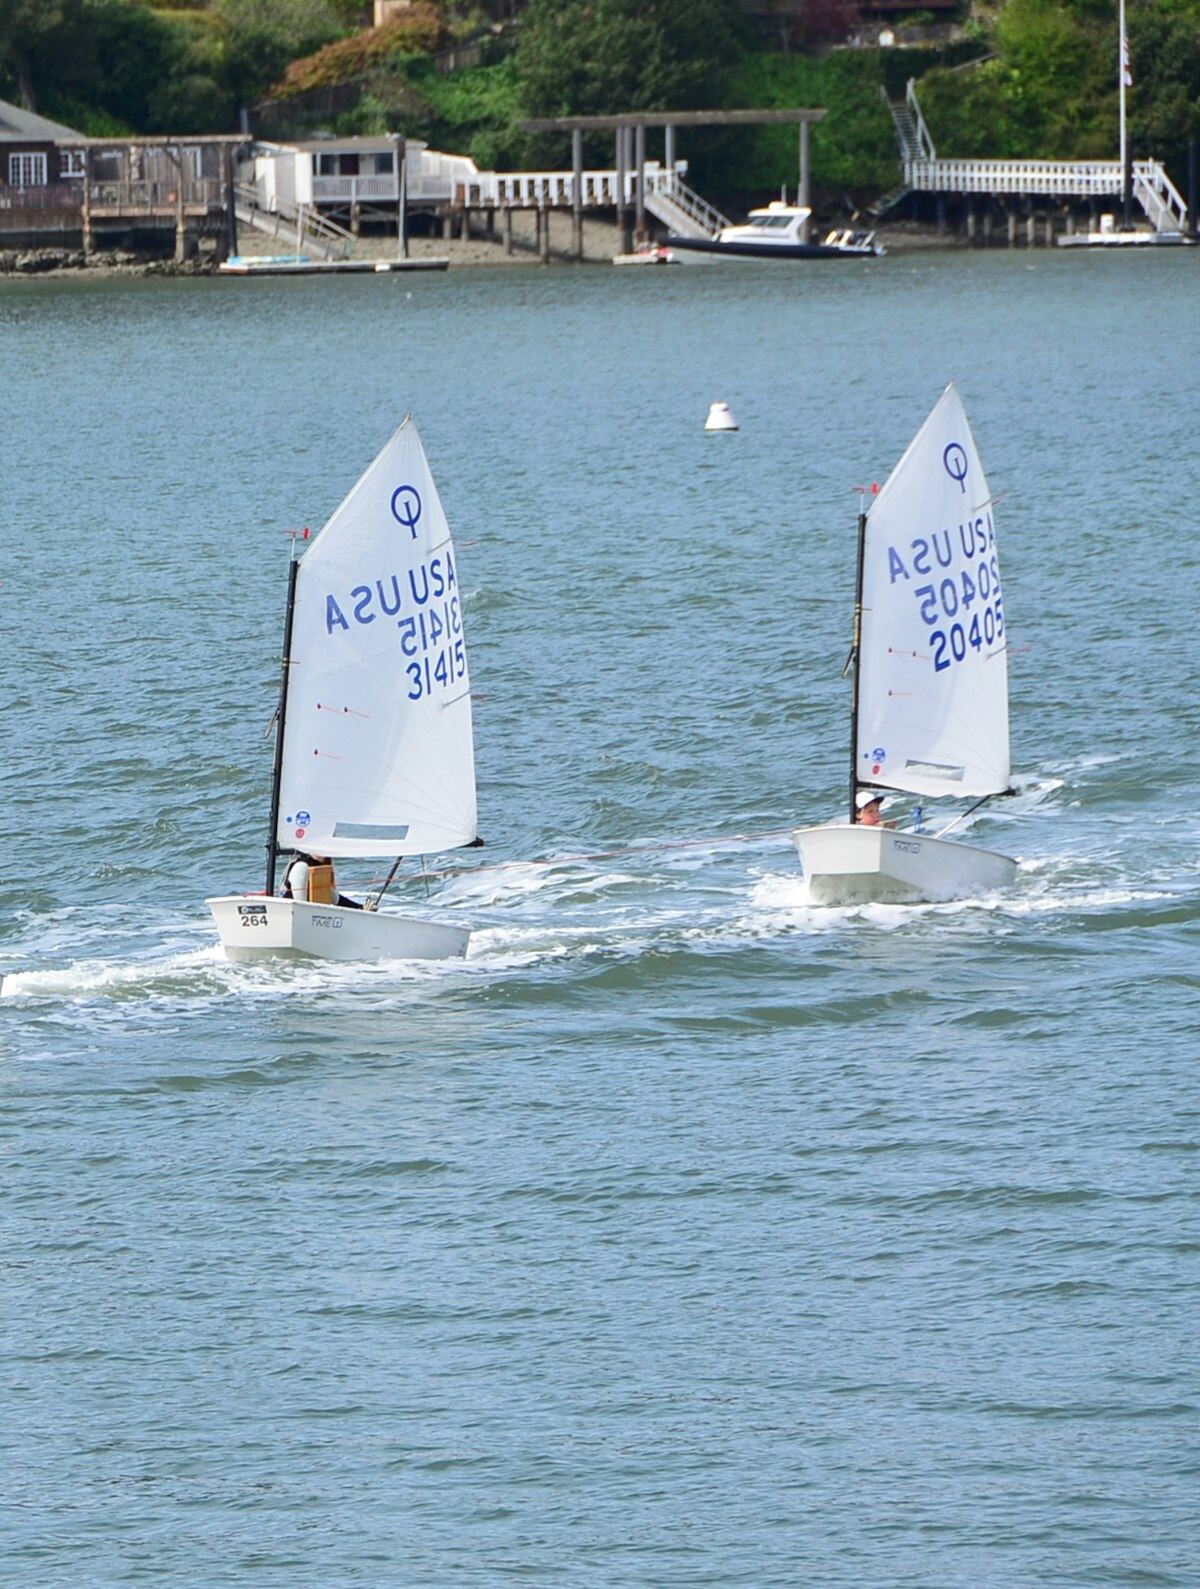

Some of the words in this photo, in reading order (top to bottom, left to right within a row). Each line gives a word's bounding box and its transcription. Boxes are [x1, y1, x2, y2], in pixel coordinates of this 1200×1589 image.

[409, 551, 456, 605] USA
[929, 597, 1004, 673] 20405
[405, 639, 465, 700] 31415
[241, 915, 268, 927] 264
